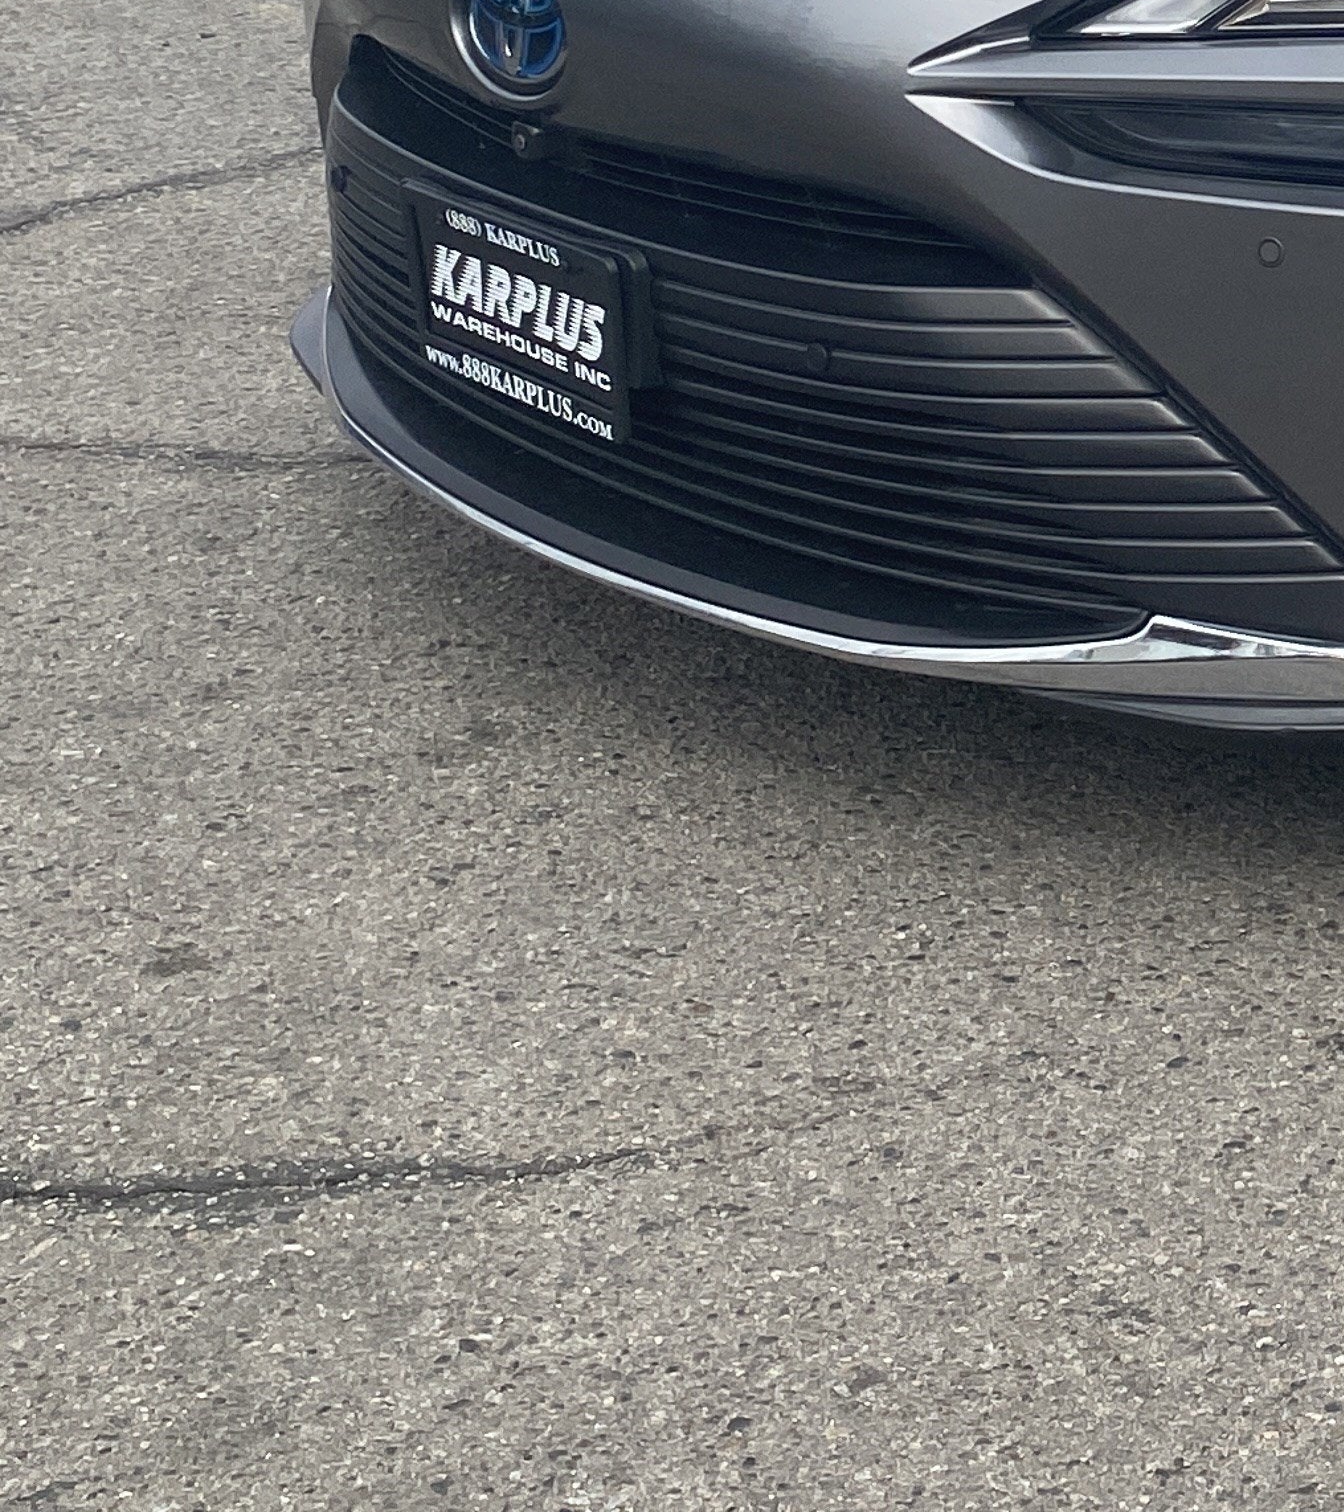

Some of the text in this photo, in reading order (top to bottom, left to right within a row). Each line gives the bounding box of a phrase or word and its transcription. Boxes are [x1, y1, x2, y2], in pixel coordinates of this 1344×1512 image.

[445, 208, 561, 267] (888) KARPLUS
[431, 243, 606, 362] KARPLUS
[431, 300, 612, 392] WAREHOUSE INC
